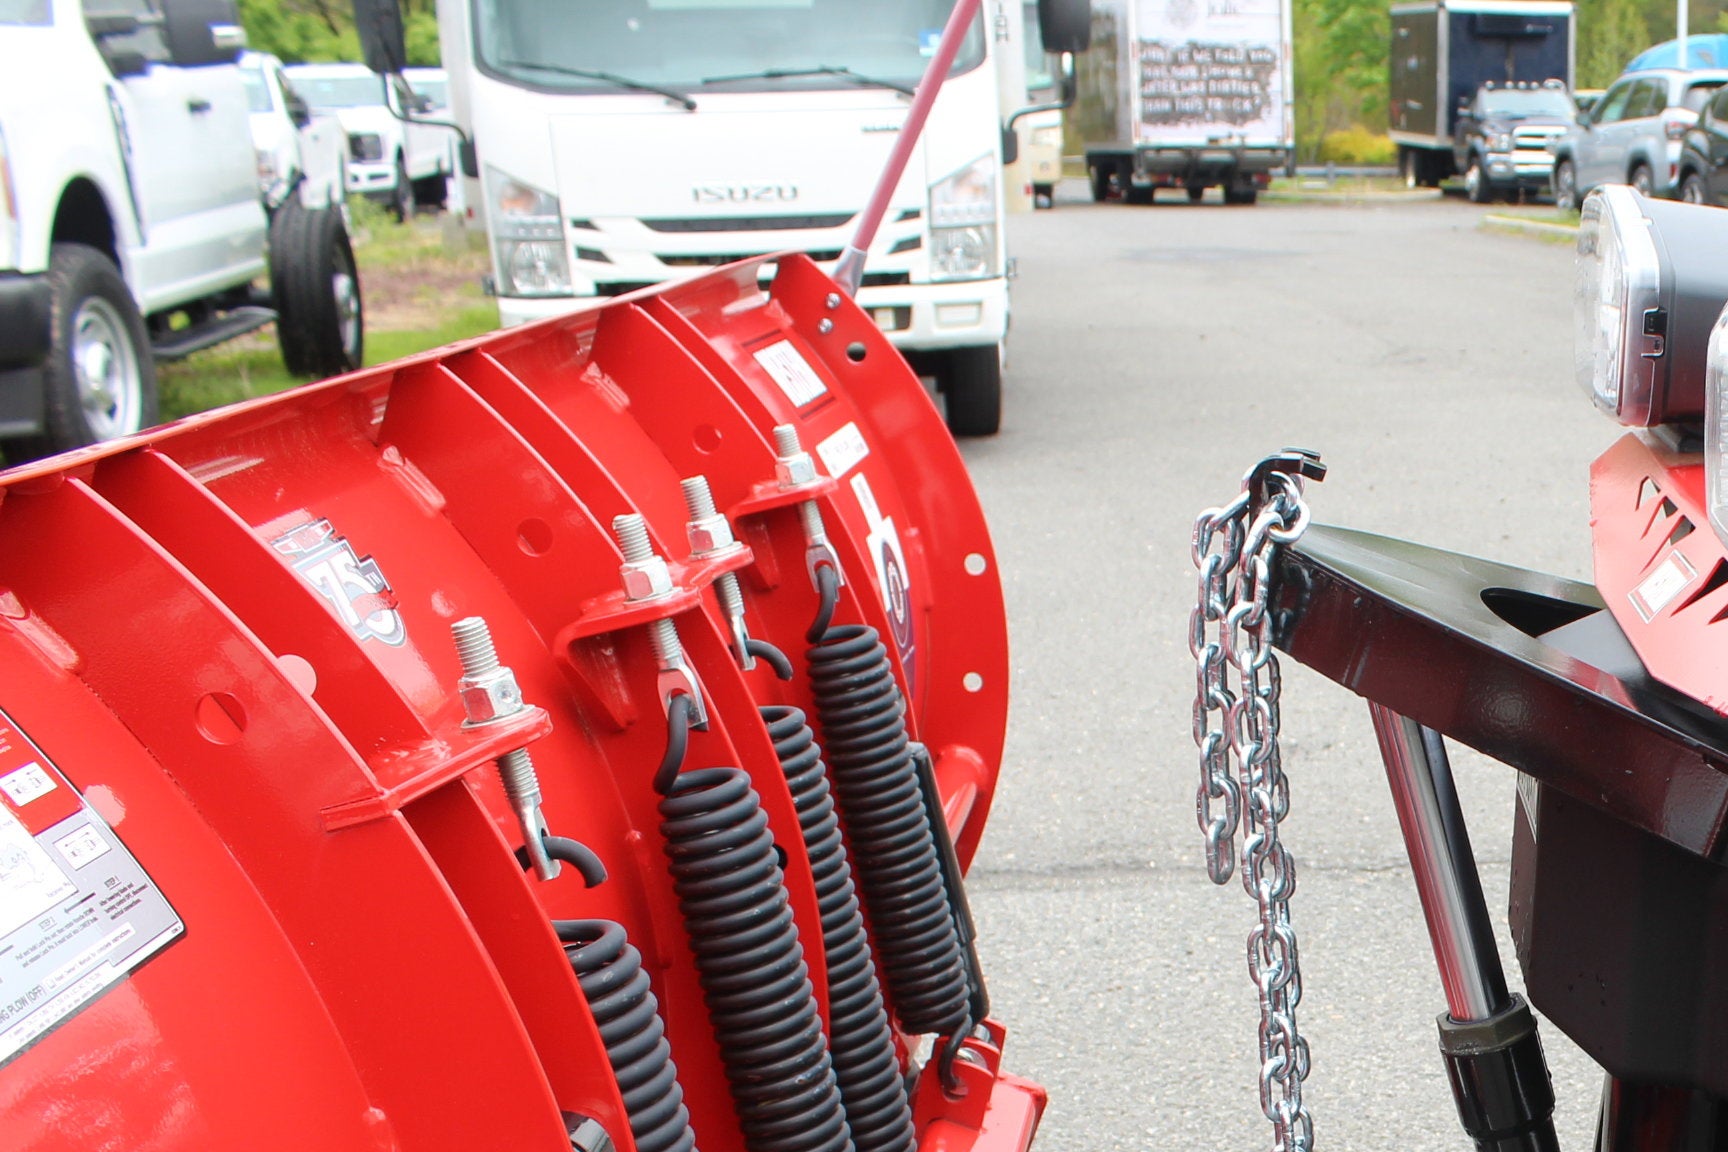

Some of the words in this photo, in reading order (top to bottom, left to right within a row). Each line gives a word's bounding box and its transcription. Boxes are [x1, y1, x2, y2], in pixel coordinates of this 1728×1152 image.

[692, 186, 799, 202] ISUZU
[7, 996, 29, 1015] PLOW
[28, 985, 47, 1003] (OFF)
